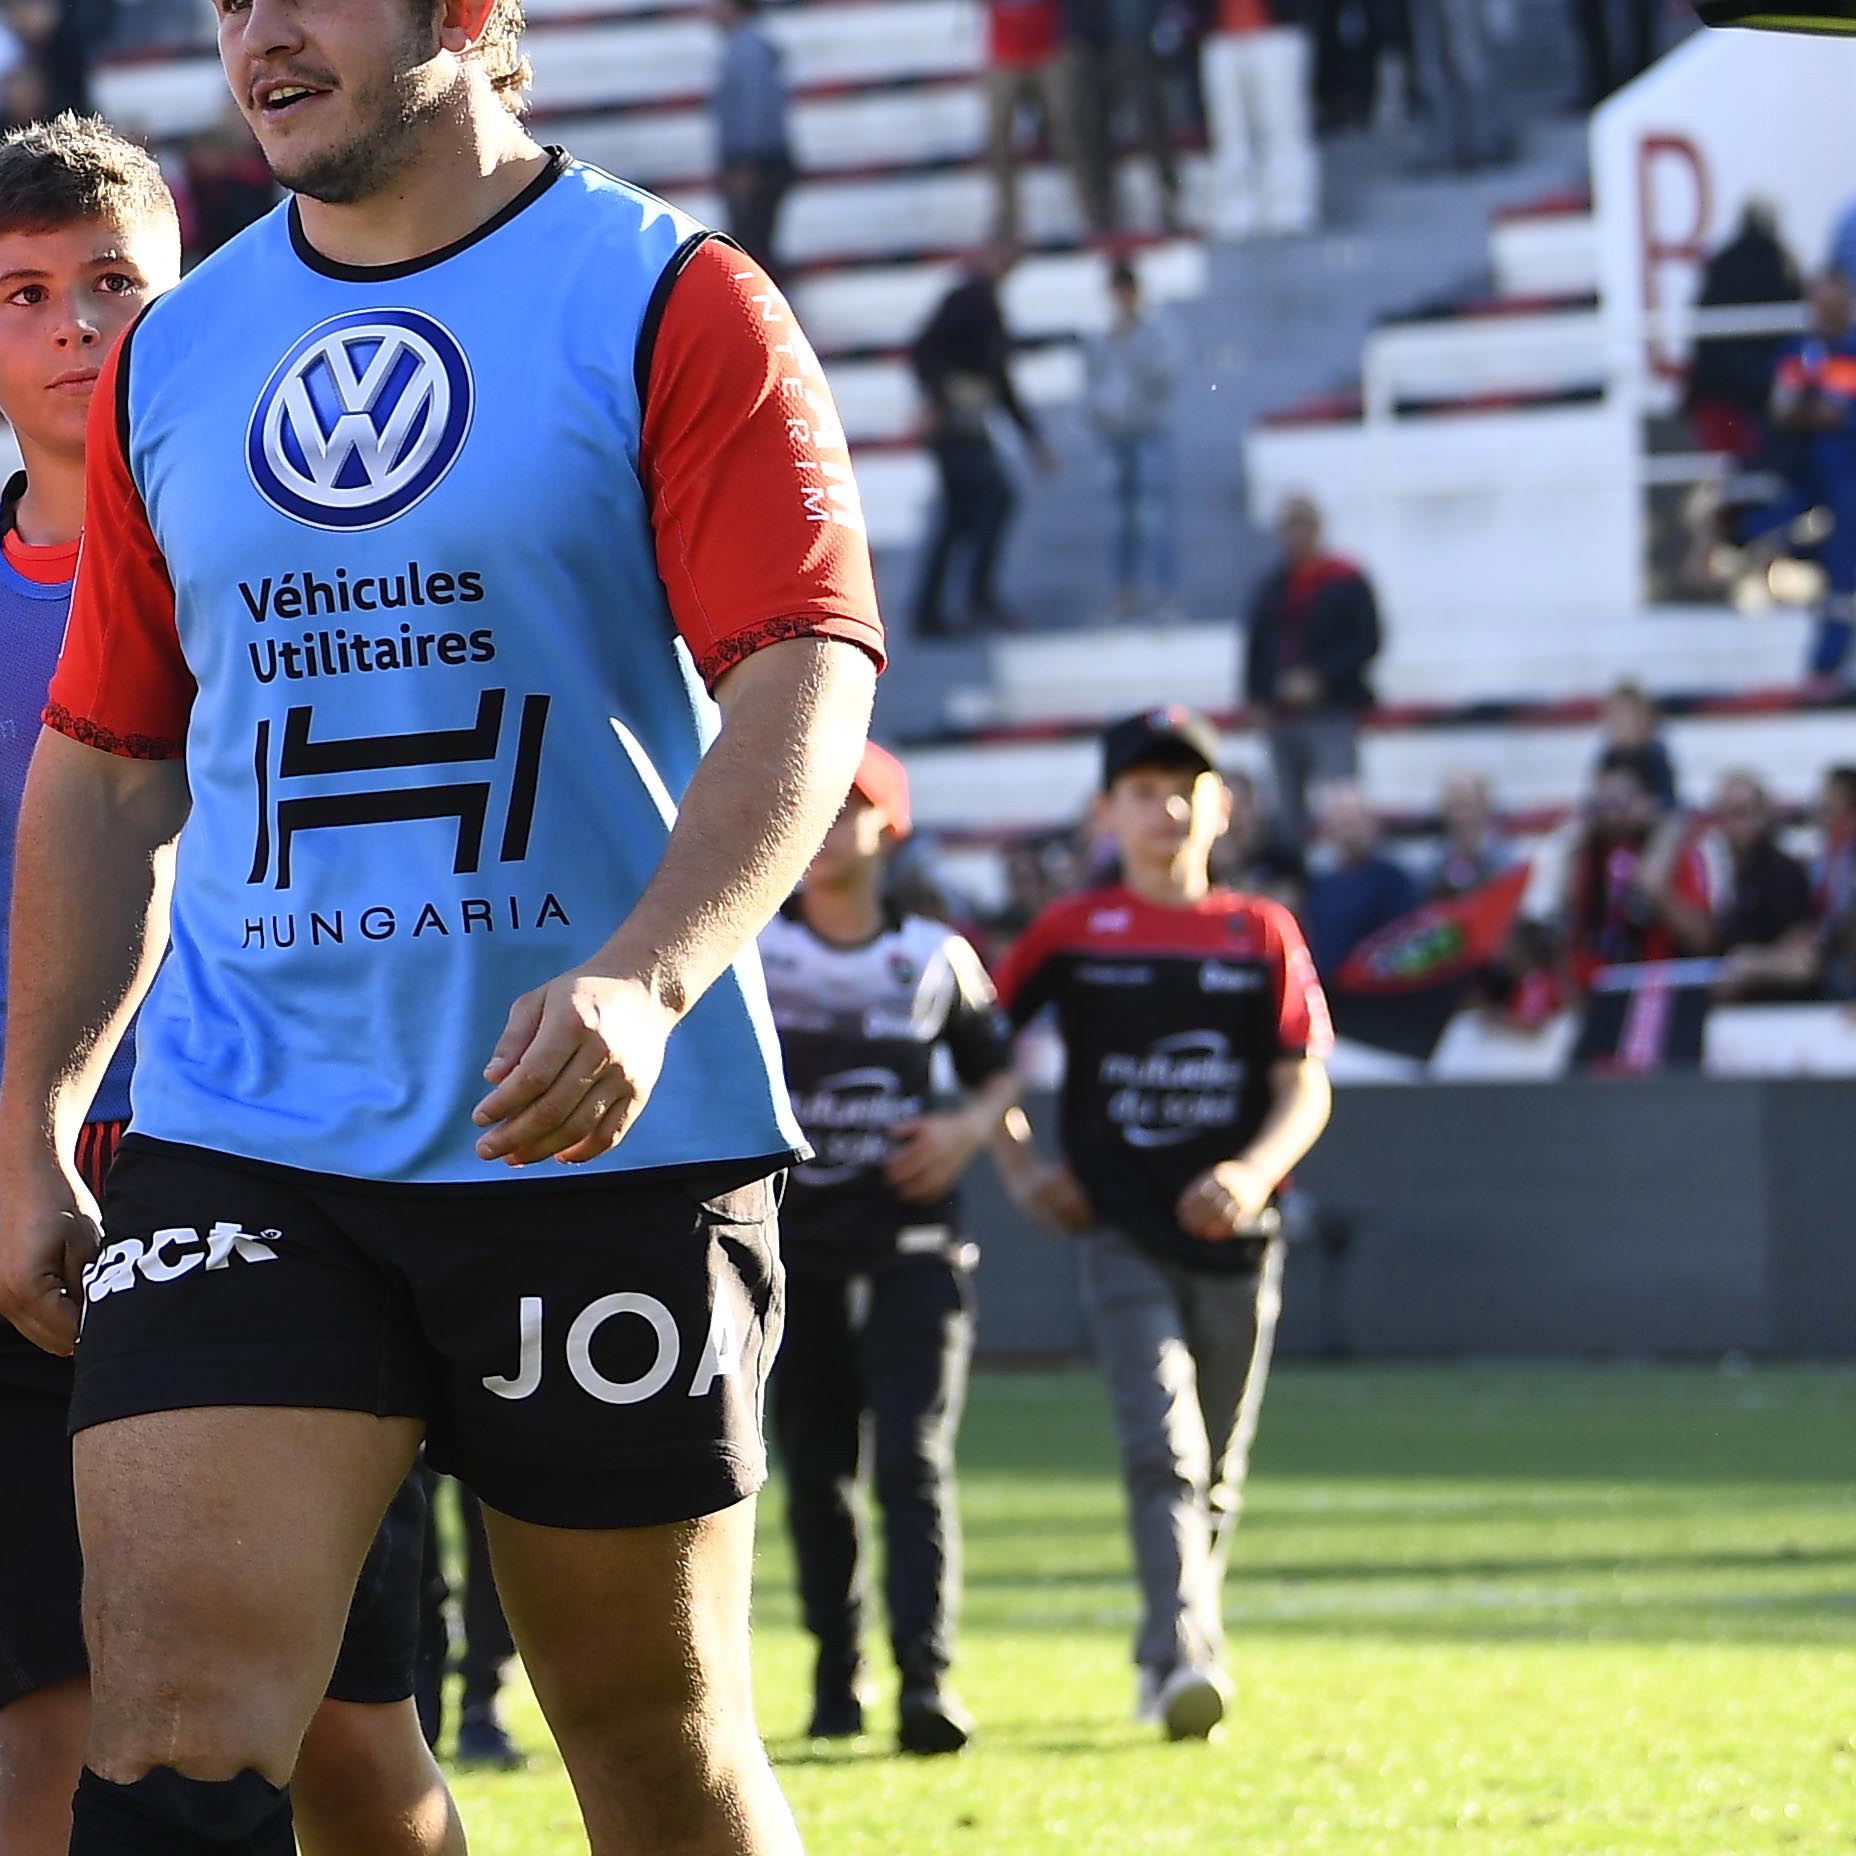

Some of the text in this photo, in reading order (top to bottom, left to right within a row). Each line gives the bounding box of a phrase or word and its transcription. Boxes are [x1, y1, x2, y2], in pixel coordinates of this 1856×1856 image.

[732, 271, 830, 522] INTERIM
[238, 561, 485, 623] Véhicules
[248, 623, 497, 684] Utilitaires
[241, 893, 571, 950] HUNGARIA
